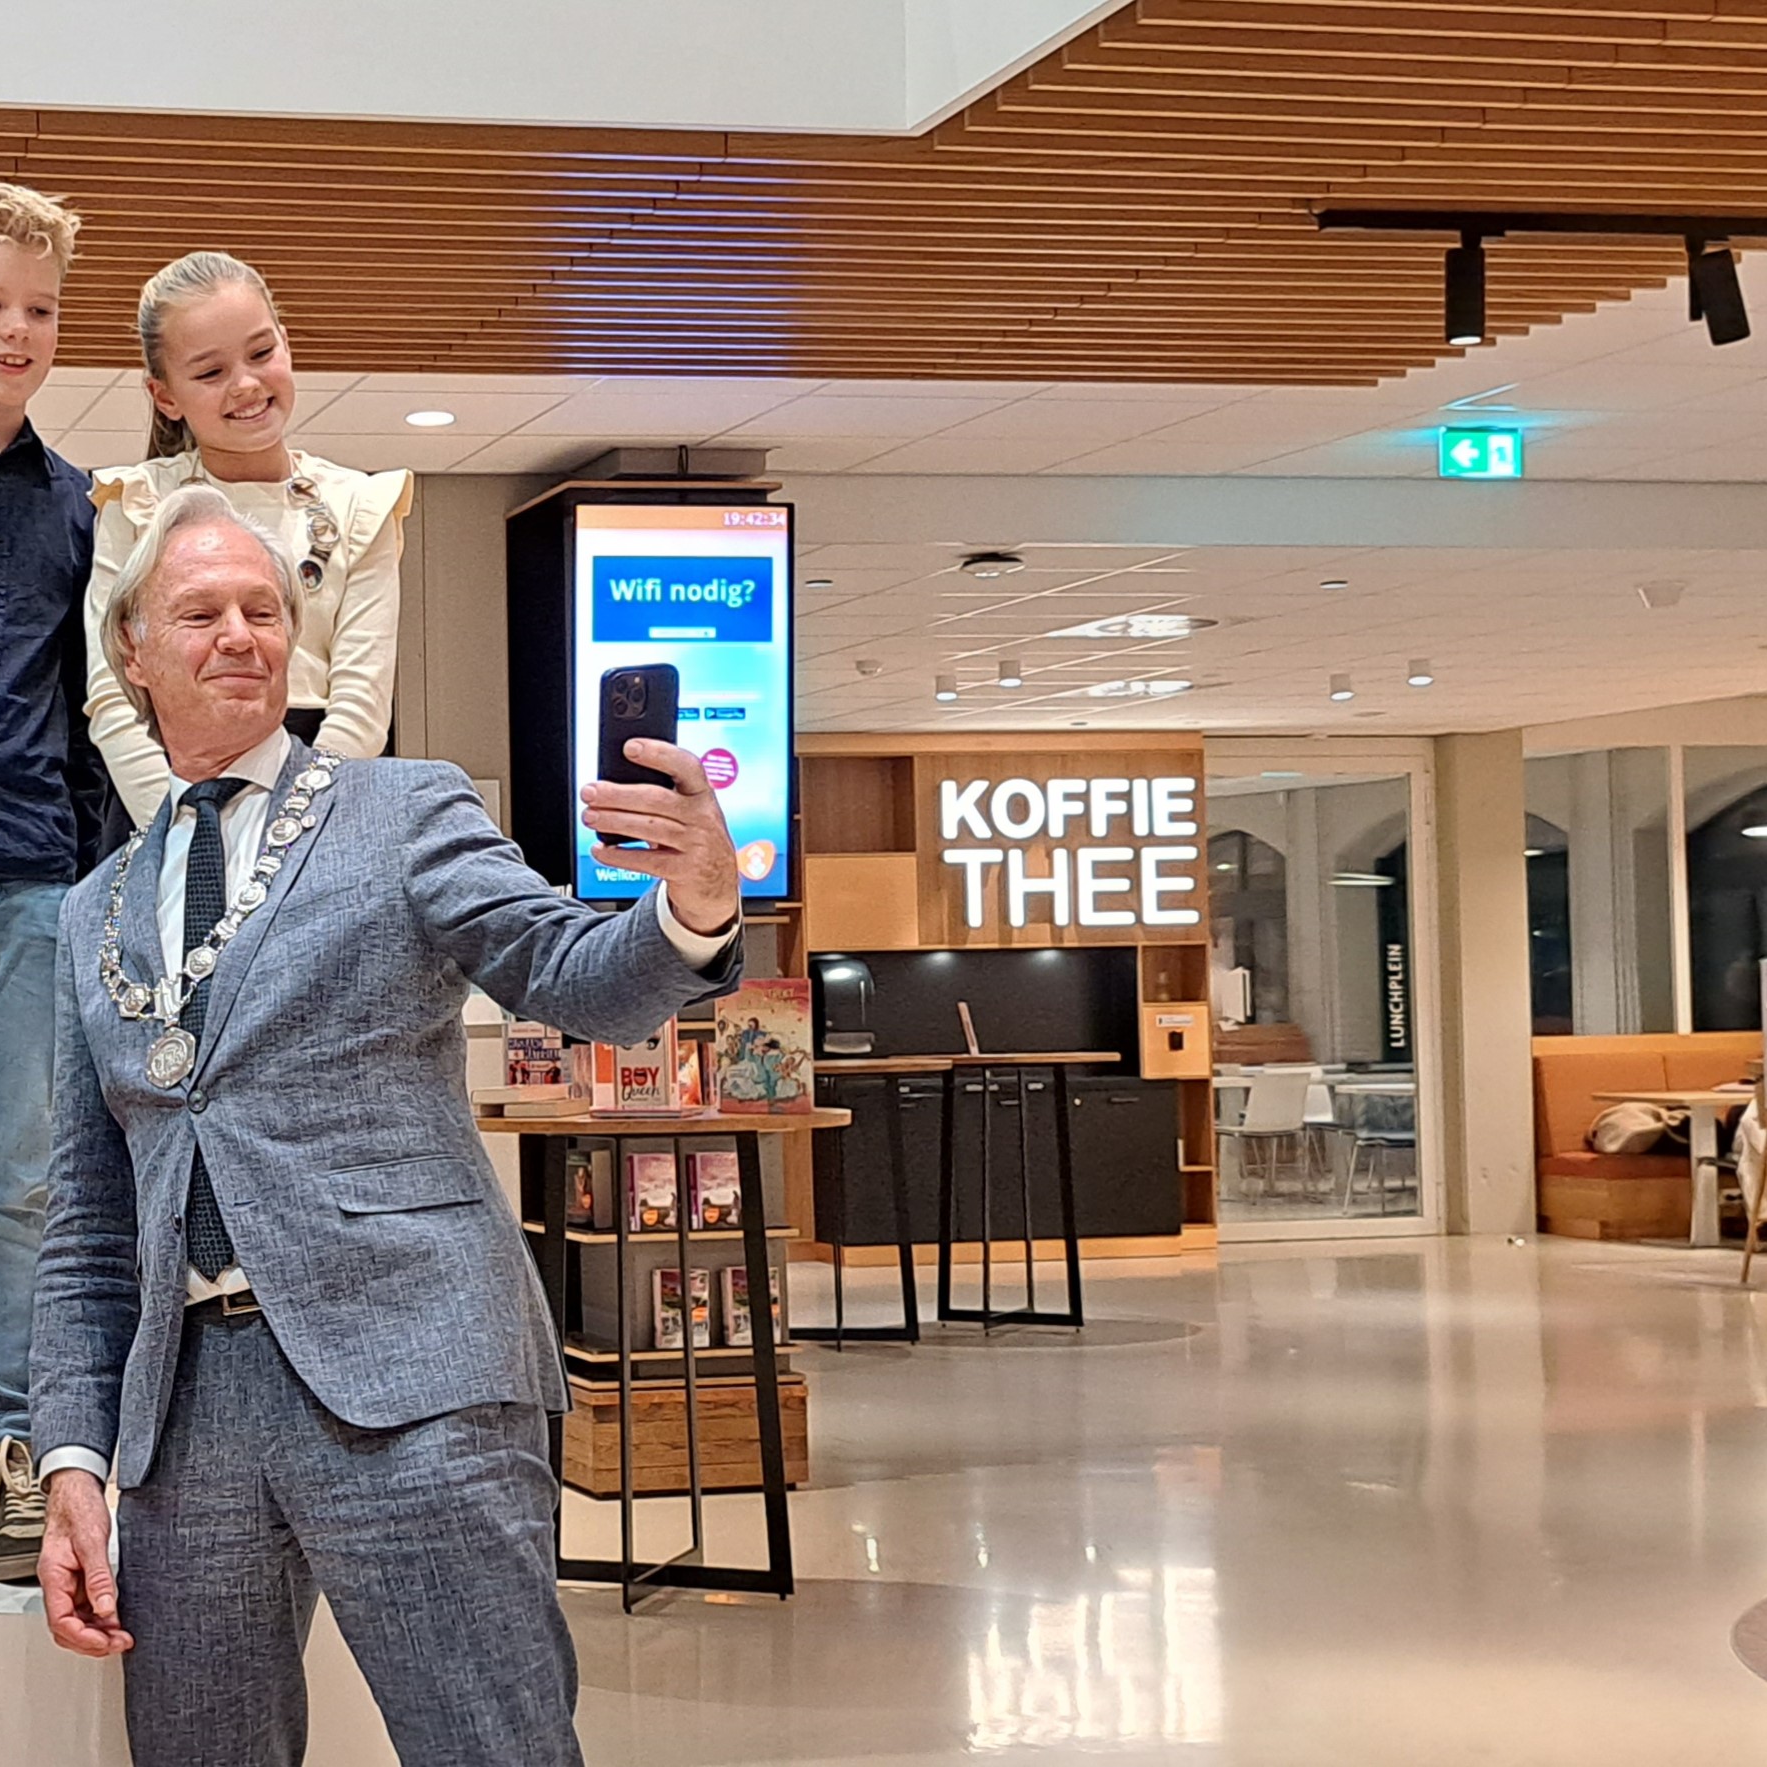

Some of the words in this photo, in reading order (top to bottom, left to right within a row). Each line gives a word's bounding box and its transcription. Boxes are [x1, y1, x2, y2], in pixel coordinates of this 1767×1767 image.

[723, 512, 786, 526] 19:42:34
[609, 578, 661, 602] Wifi
[670, 578, 756, 608] nodig?
[940, 777, 1198, 840] KOFFIE
[942, 846, 1200, 928] THEE
[1386, 943, 1406, 1048] LUNCHPLEIN
[621, 1067, 660, 1088] BOY
[621, 1085, 661, 1101] Queen
